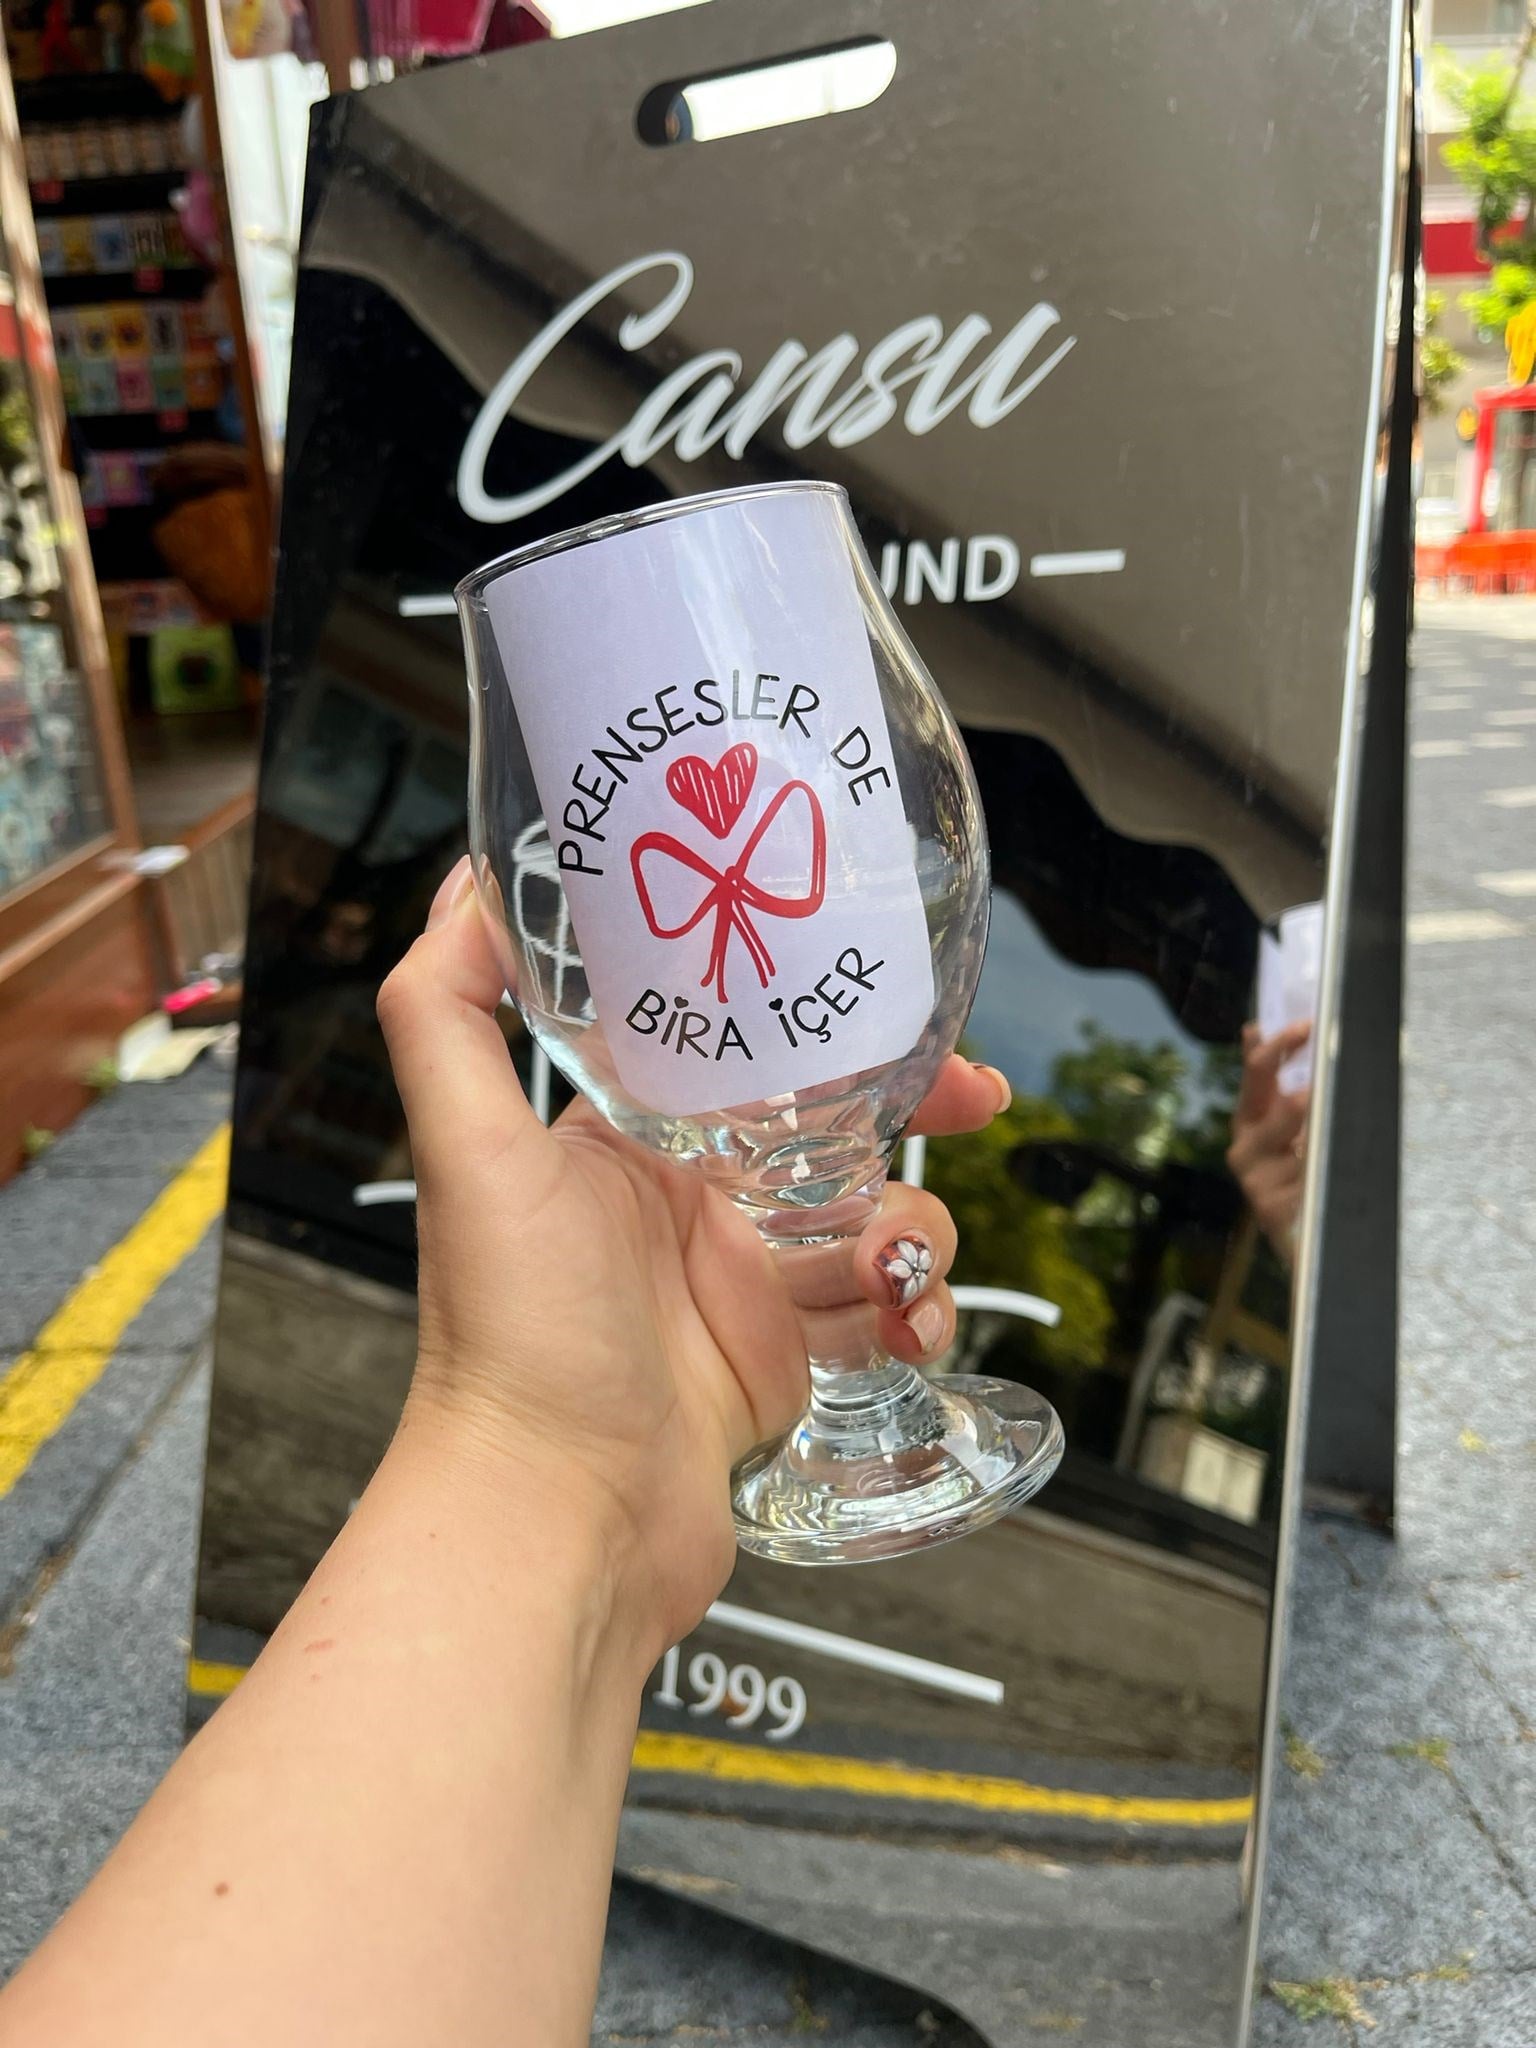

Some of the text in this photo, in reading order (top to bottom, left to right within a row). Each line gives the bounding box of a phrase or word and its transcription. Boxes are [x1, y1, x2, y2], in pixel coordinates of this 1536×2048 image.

[457, 251, 1078, 523] Cansu
[558, 669, 891, 876] PRENSESLER DE
[652, 1645, 807, 1741] 1999
